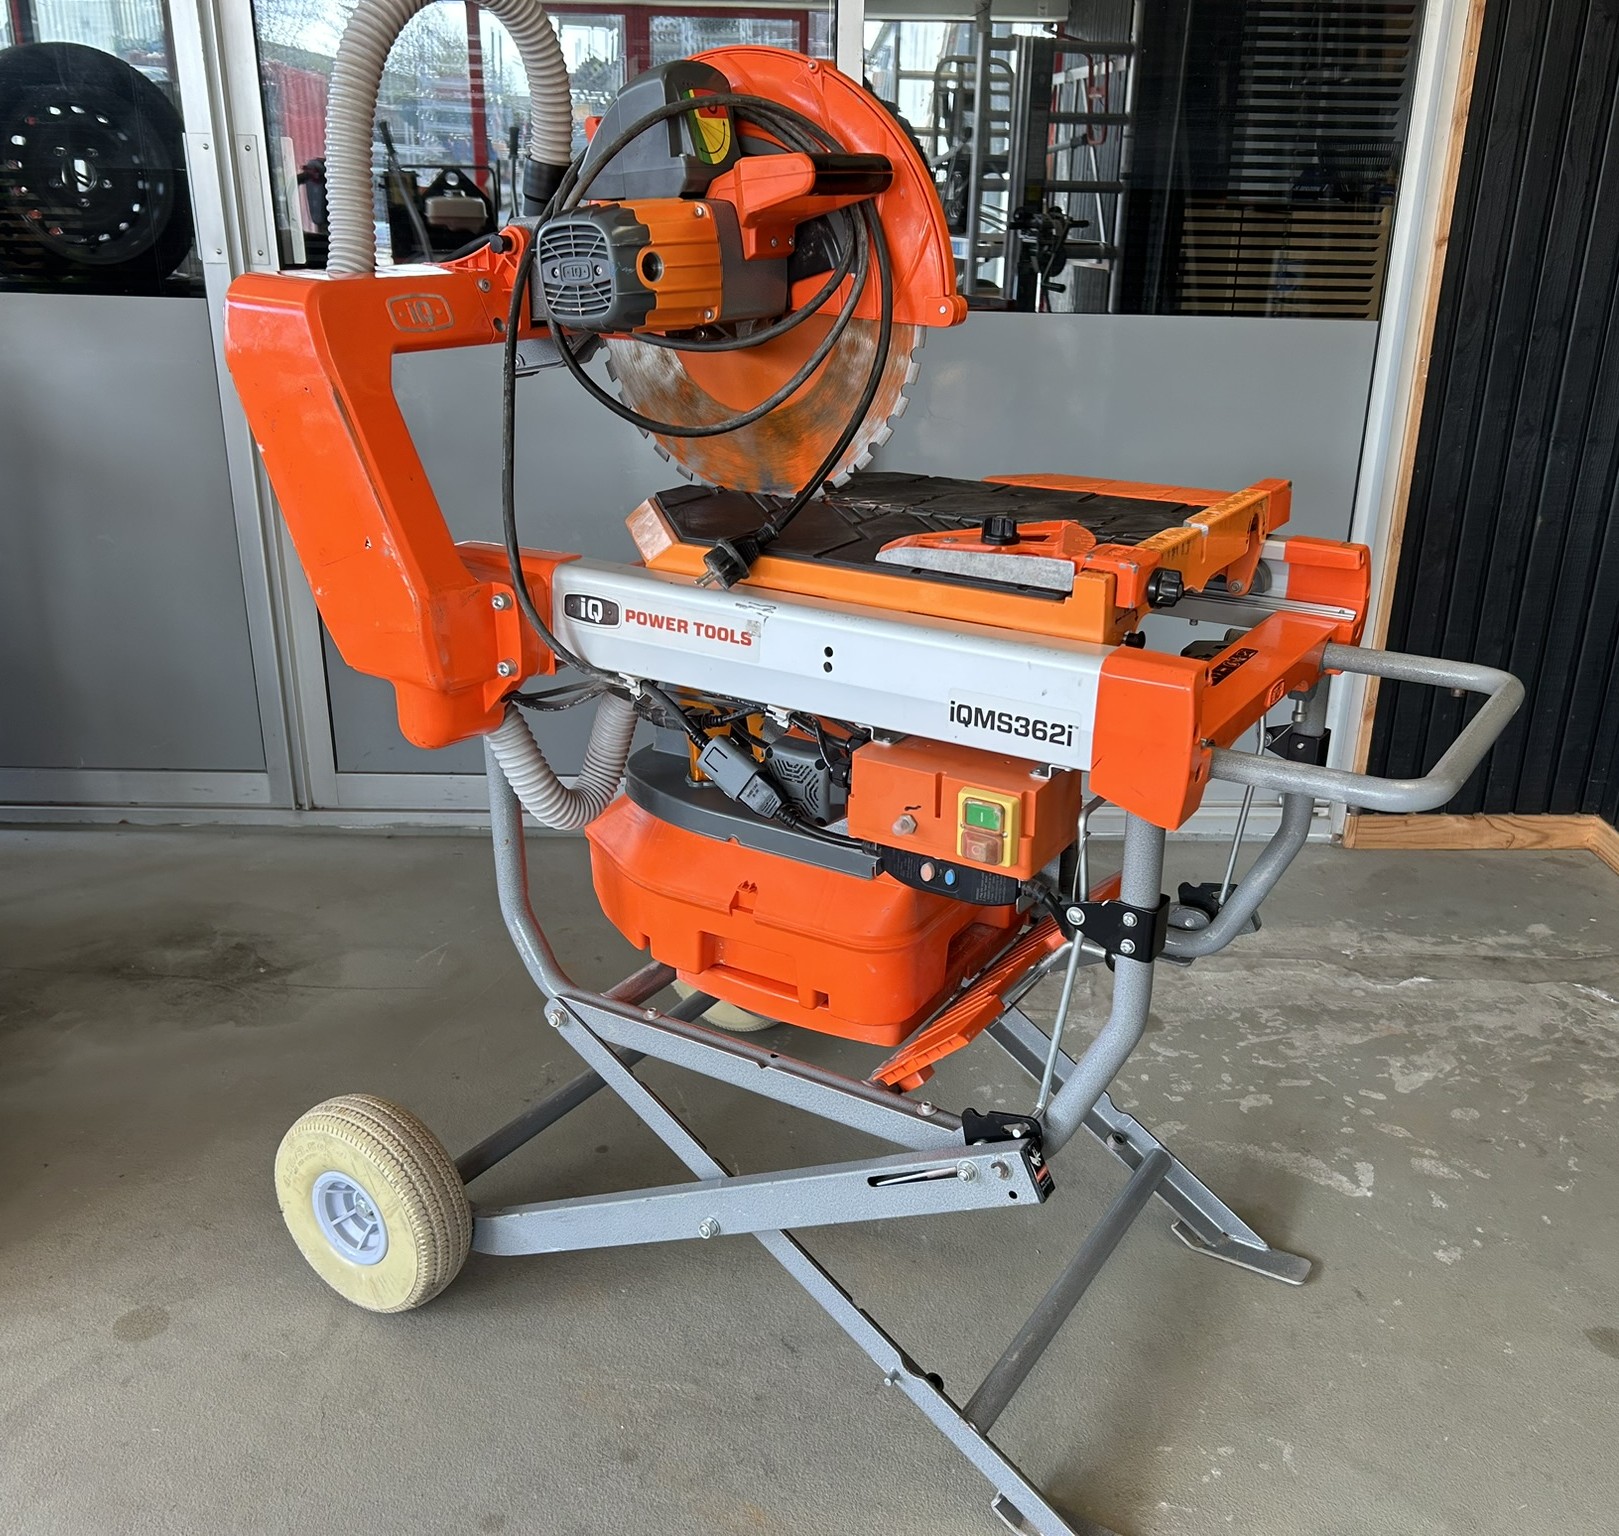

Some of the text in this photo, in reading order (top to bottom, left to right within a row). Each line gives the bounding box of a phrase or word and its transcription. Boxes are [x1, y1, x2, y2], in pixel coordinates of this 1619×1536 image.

[580, 597, 603, 623] iQ
[625, 608, 752, 646] POWER TOOLS
[949, 700, 1073, 747] iQMS362i
